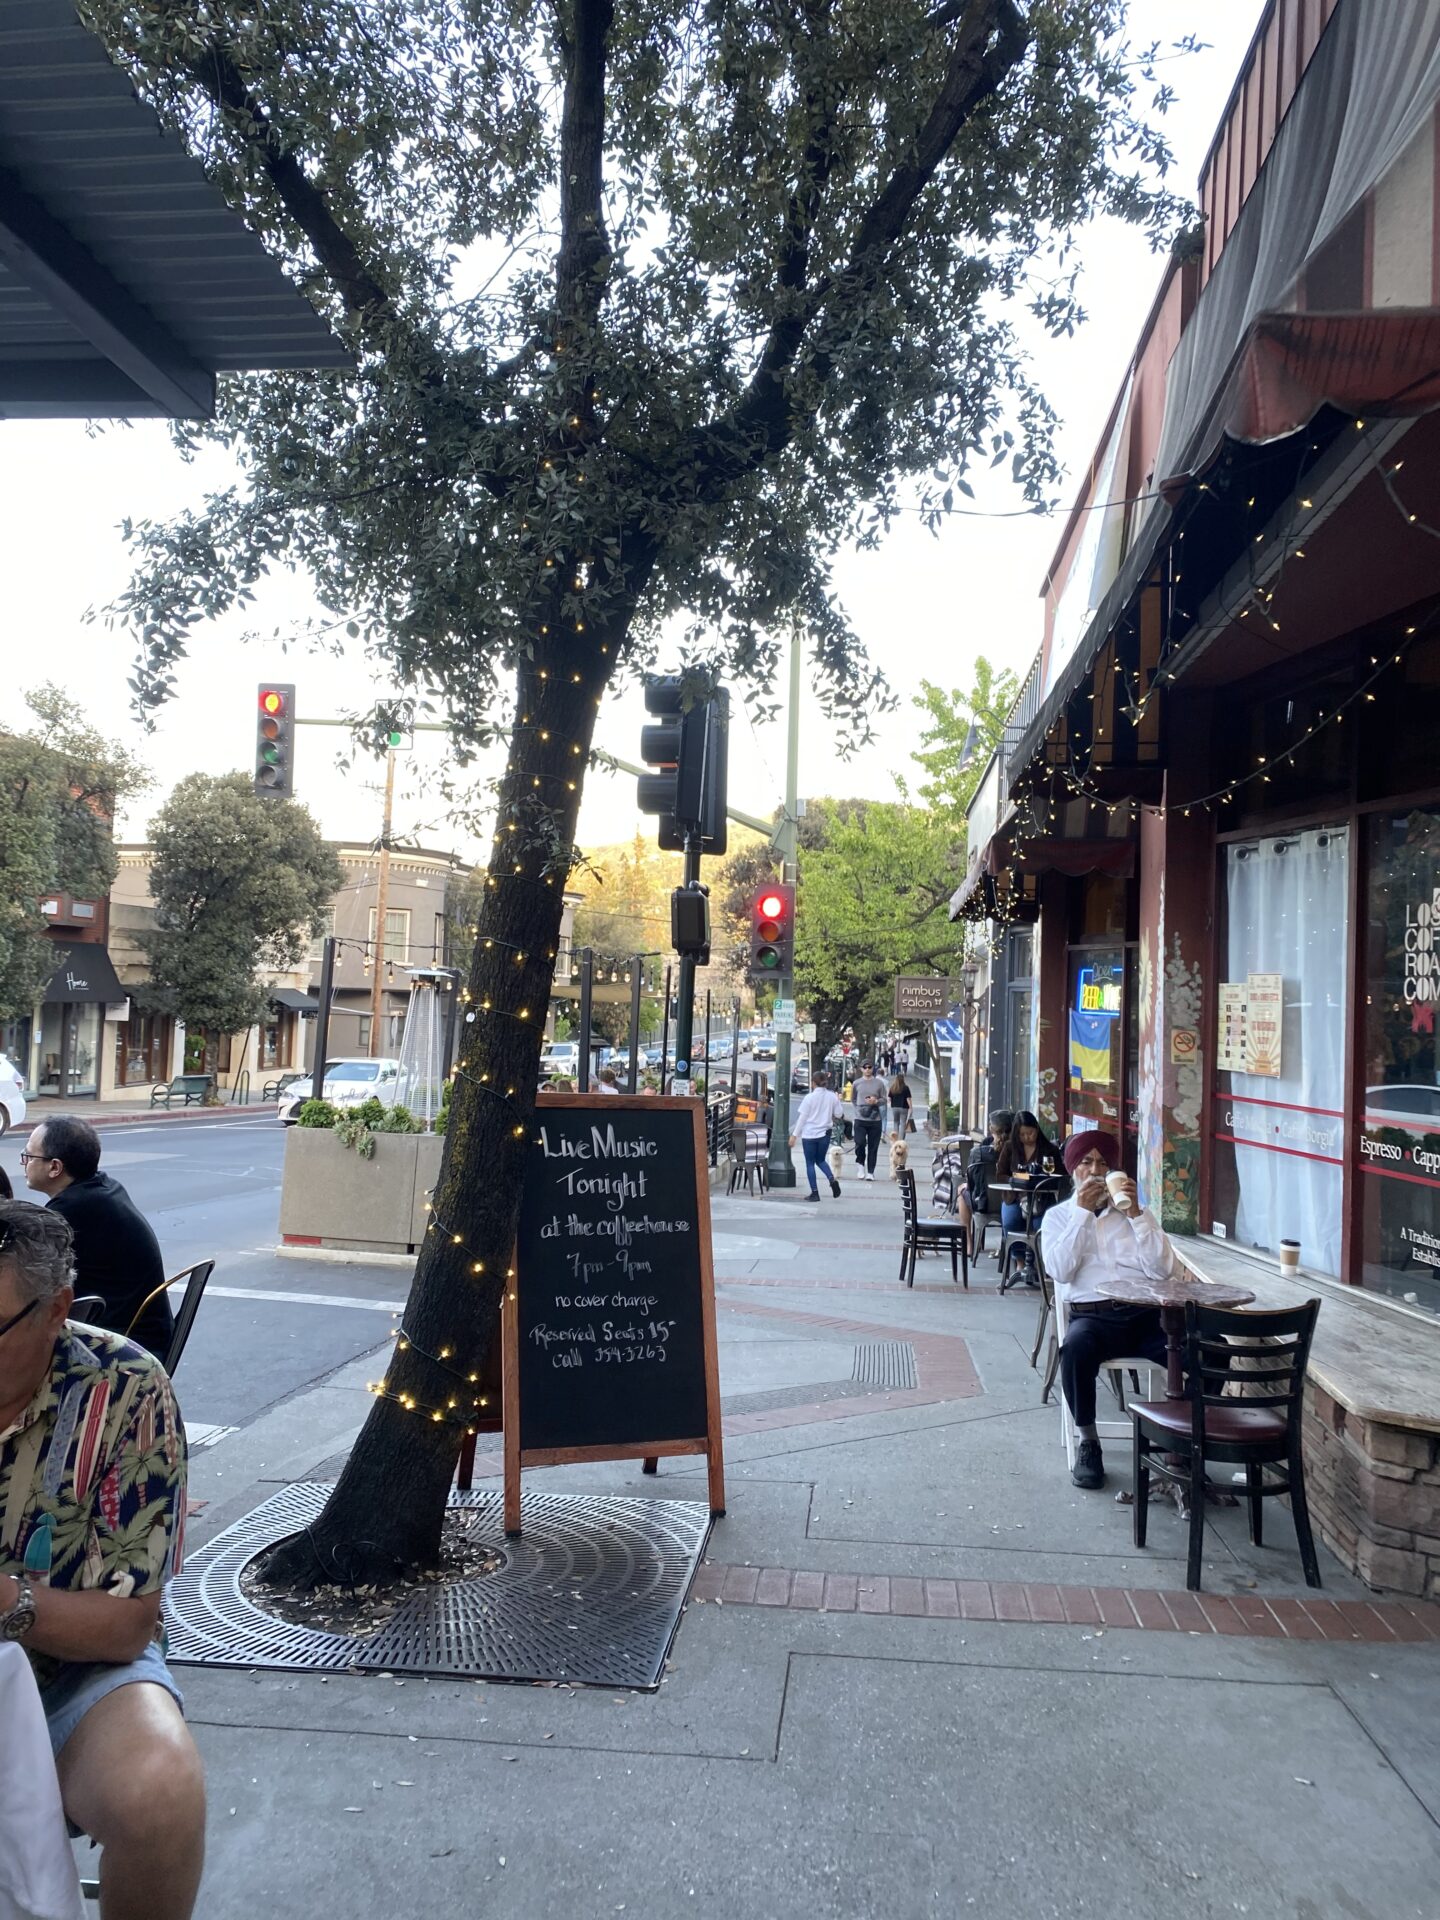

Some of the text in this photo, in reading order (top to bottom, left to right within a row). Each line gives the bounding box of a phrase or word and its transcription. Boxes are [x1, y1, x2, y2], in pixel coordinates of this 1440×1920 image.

[902, 985, 941, 997] nimbus
[902, 996, 932, 1008] salon
[1082, 984, 1099, 1010] BEER
[540, 1123, 658, 1159] Live Music
[1360, 1135, 1402, 1160] Espresso
[556, 1167, 648, 1212] Tonight
[540, 1213, 691, 1246] at the coffeehouse
[1400, 1226, 1407, 1240] A
[555, 1291, 659, 1317] no cover charge
[529, 1323, 596, 1350] Reserved
[602, 1321, 645, 1342] Seats
